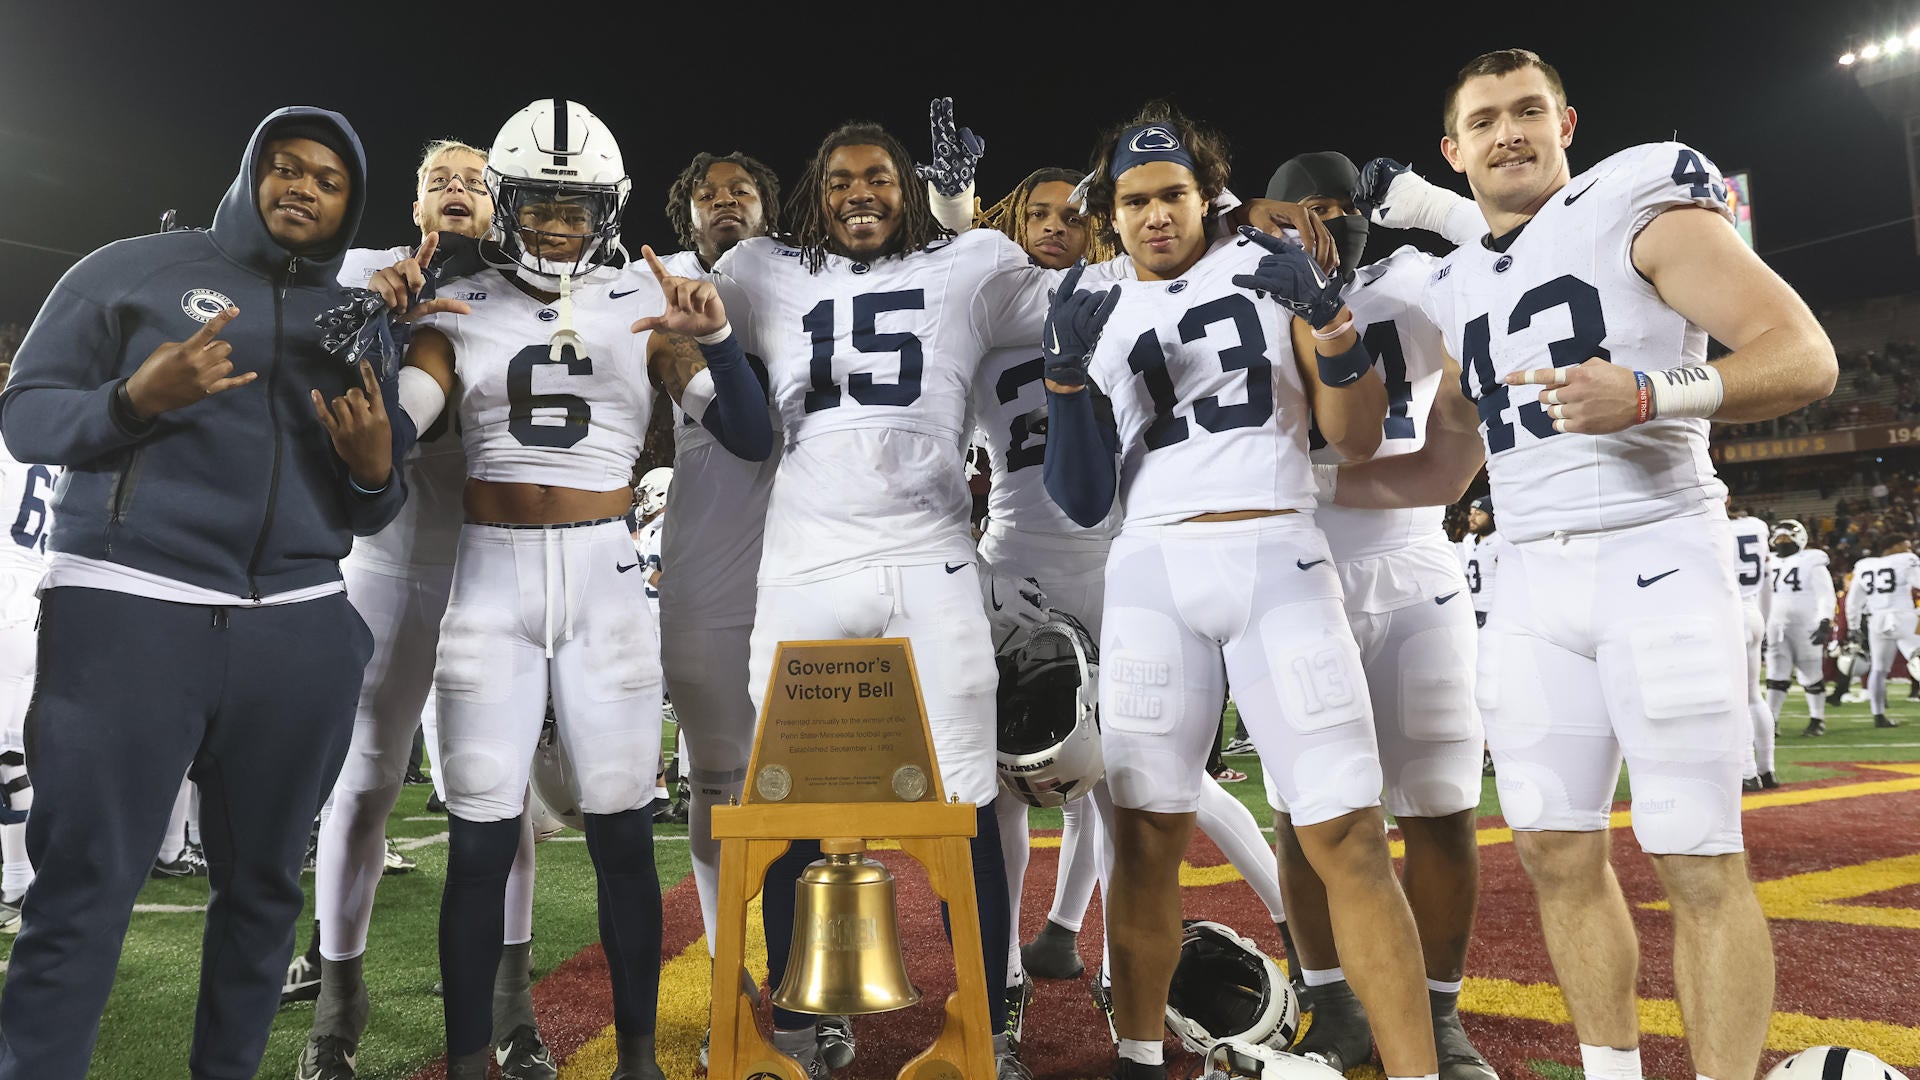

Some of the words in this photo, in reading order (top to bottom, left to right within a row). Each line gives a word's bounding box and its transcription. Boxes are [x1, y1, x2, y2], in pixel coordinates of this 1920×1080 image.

[802, 288, 925, 414] 15
[1460, 273, 1612, 455] 43
[1127, 292, 1273, 452] 13
[506, 344, 594, 449] 6
[10, 464, 59, 556] 6
[1736, 534, 1762, 587] 5
[1771, 566, 1803, 593] 74
[1861, 567, 1897, 596] 33
[787, 657, 892, 677] Governor's
[1111, 659, 1169, 686] JESUS
[1292, 648, 1355, 715] 13
[785, 684, 852, 703] Victory
[858, 681, 894, 699] Bell
[1115, 691, 1161, 719] KING
[780, 732, 798, 740] Penn
